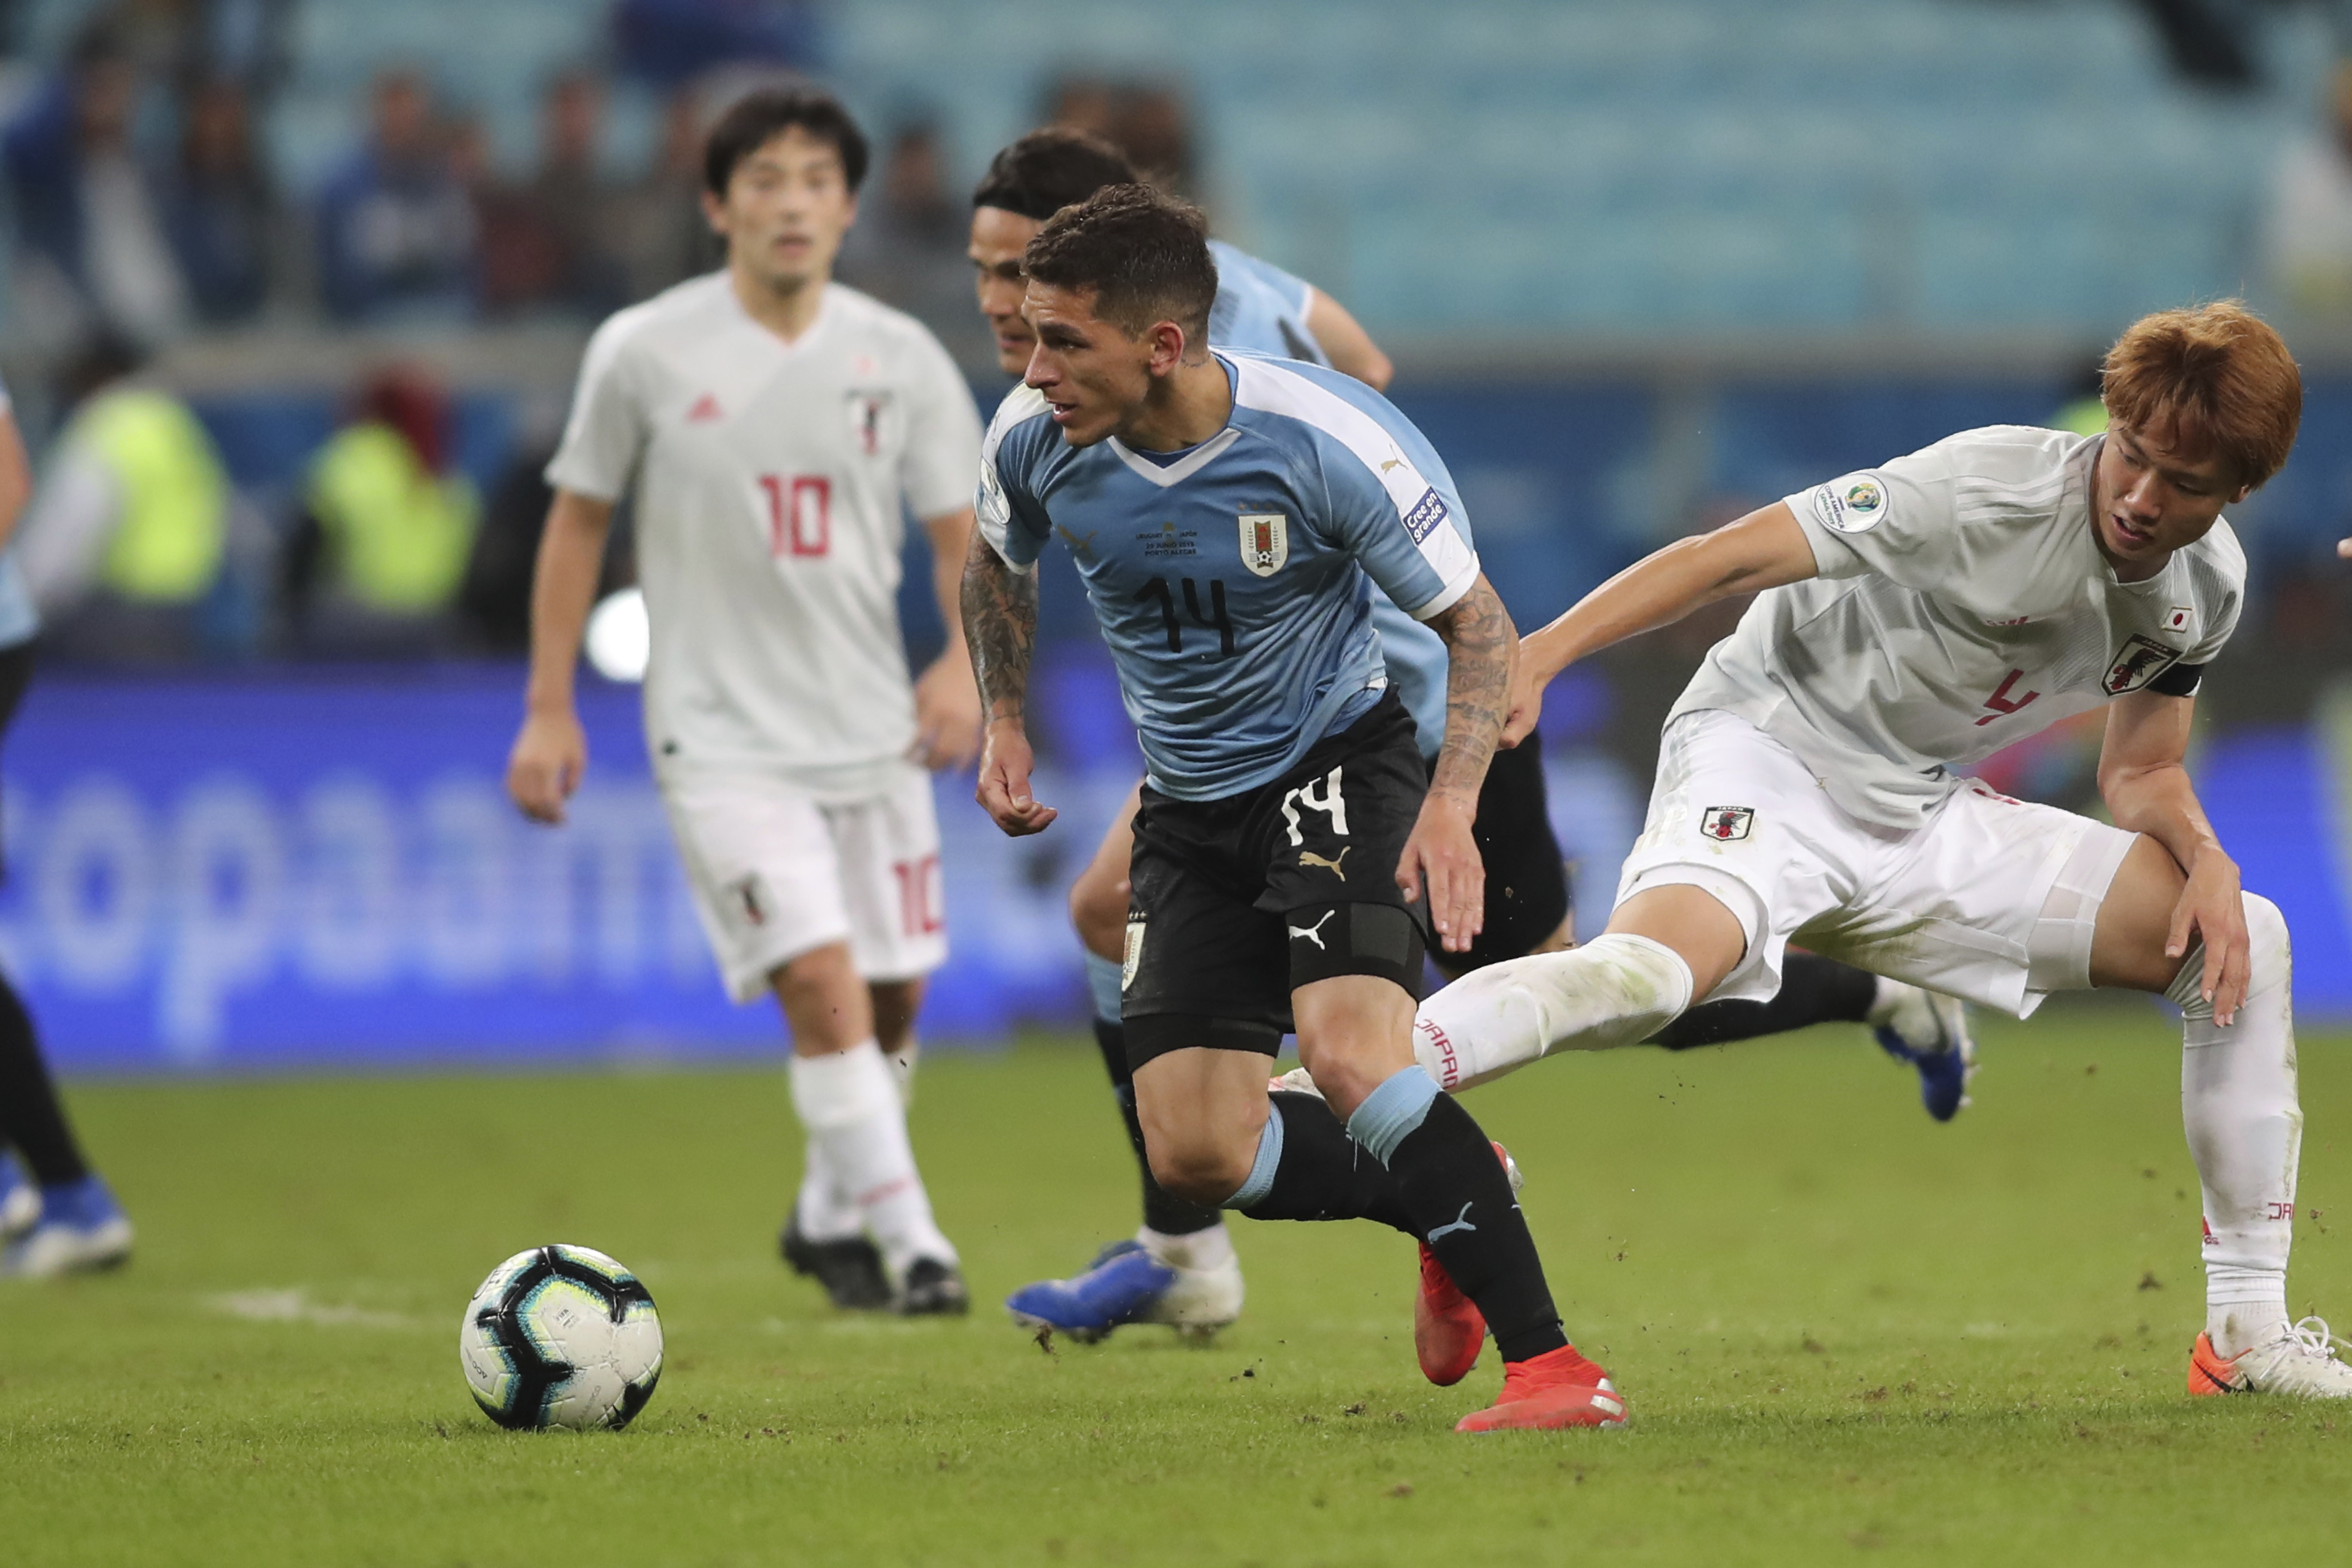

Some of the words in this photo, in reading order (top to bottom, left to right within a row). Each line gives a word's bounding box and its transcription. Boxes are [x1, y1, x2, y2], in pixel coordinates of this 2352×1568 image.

[756, 474, 832, 559] 10
[1407, 505, 1427, 528] Cree
[1426, 493, 1437, 507] en
[1414, 504, 1442, 541] grande
[1133, 578, 1234, 656] 14
[1974, 669, 2040, 726] 4
[1281, 766, 1349, 846] 14
